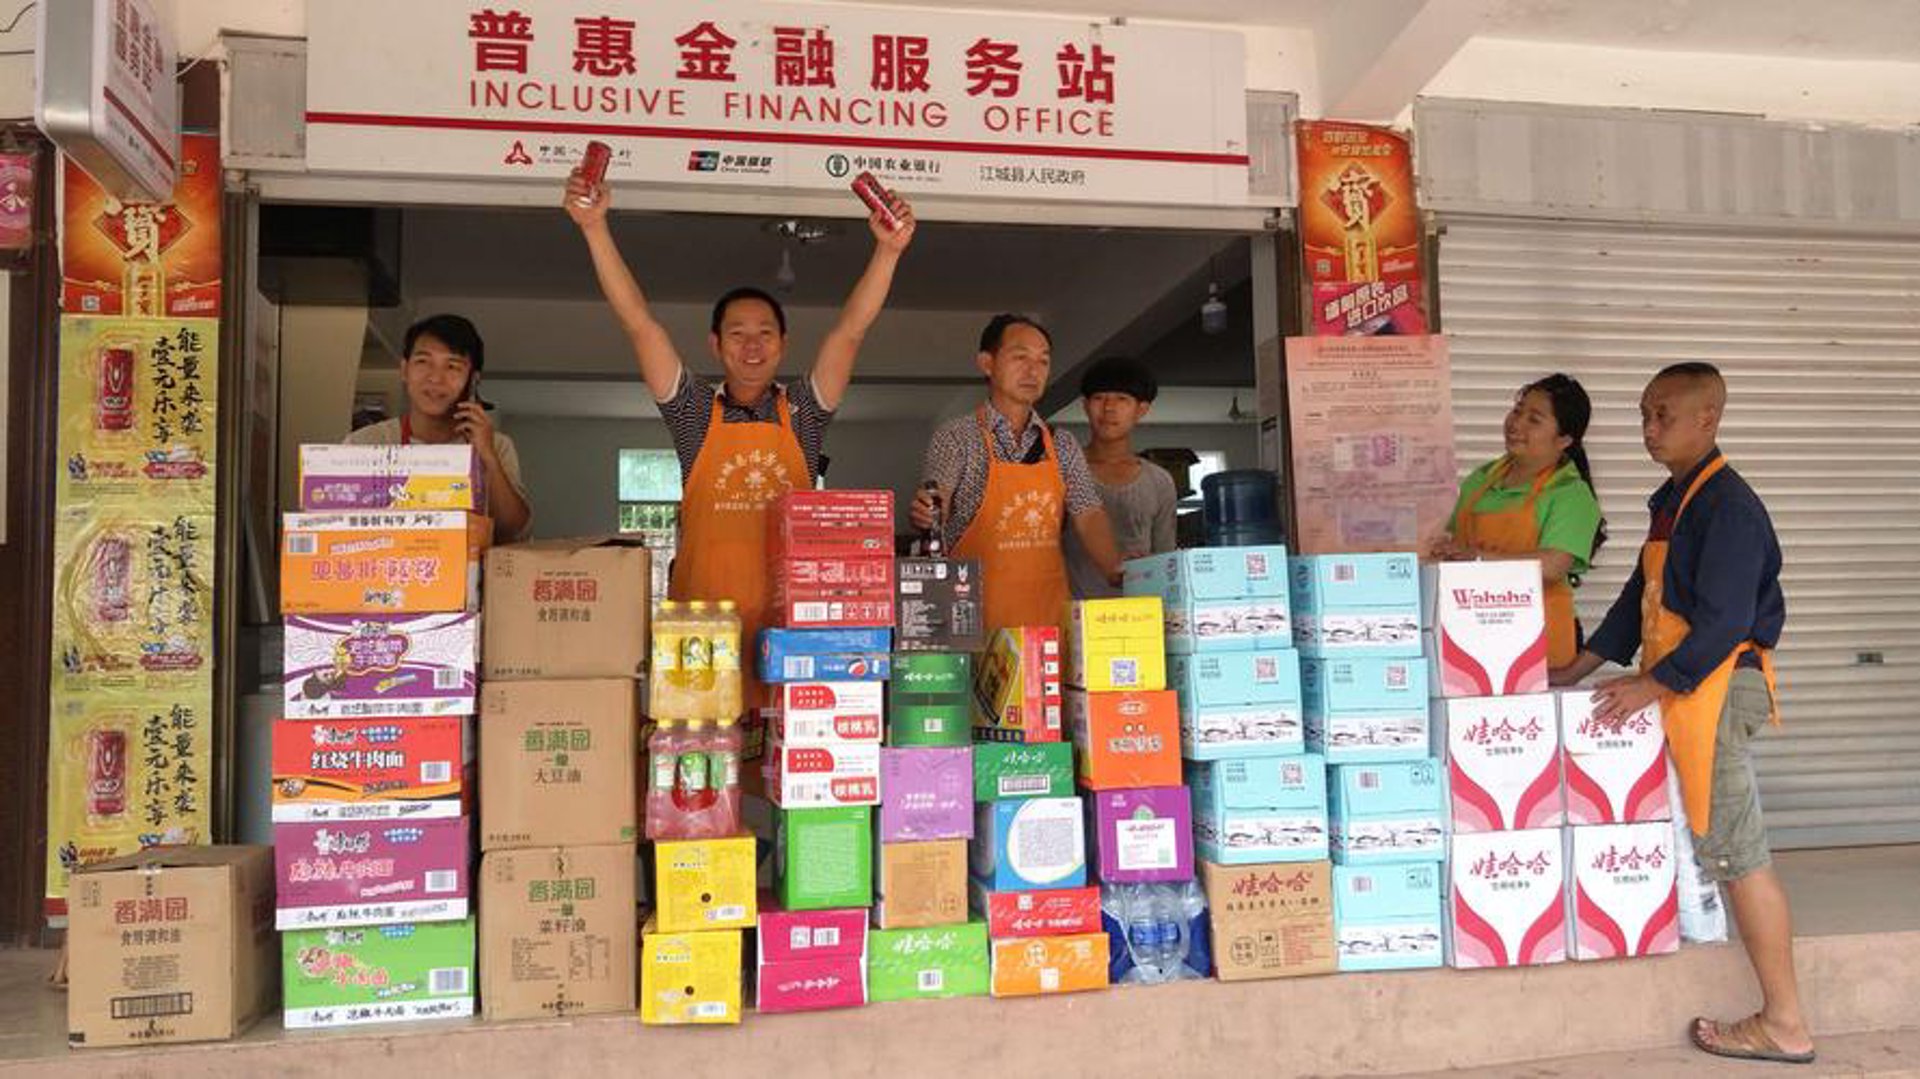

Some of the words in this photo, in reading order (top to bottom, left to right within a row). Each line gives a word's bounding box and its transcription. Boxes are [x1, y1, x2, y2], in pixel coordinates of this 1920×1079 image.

[469, 9, 1115, 105] 普惠金融服务站
[470, 79, 686, 117] INCLUSIVE
[723, 91, 949, 129] FINANCING
[984, 103, 1114, 138] OFFICE
[539, 145, 632, 158] 中国人行
[852, 155, 941, 174] 中国农业银行
[979, 164, 1086, 186] 江城县人民政府
[151, 336, 177, 444] 壹元乐享
[177, 327, 203, 438] 能量来袭
[533, 579, 598, 602] 香满园
[1452, 588, 1531, 604] Wahaha
[525, 729, 592, 752] 香满园
[1463, 716, 1543, 745] 娃哈哈
[143, 715, 171, 827] 壹元乐享
[170, 703, 198, 818] 能量来袭
[311, 750, 406, 770] 红烧牛肉面
[535, 768, 582, 784] 大豆油
[1470, 850, 1550, 879] 娃哈哈
[1592, 845, 1668, 873] 娃哈哈
[529, 877, 596, 903] 香满园
[1232, 871, 1309, 897] 娃哈哈
[113, 897, 189, 925] 香满园
[540, 918, 587, 934] 菜籽油
[893, 930, 953, 954] 娃哈哈
